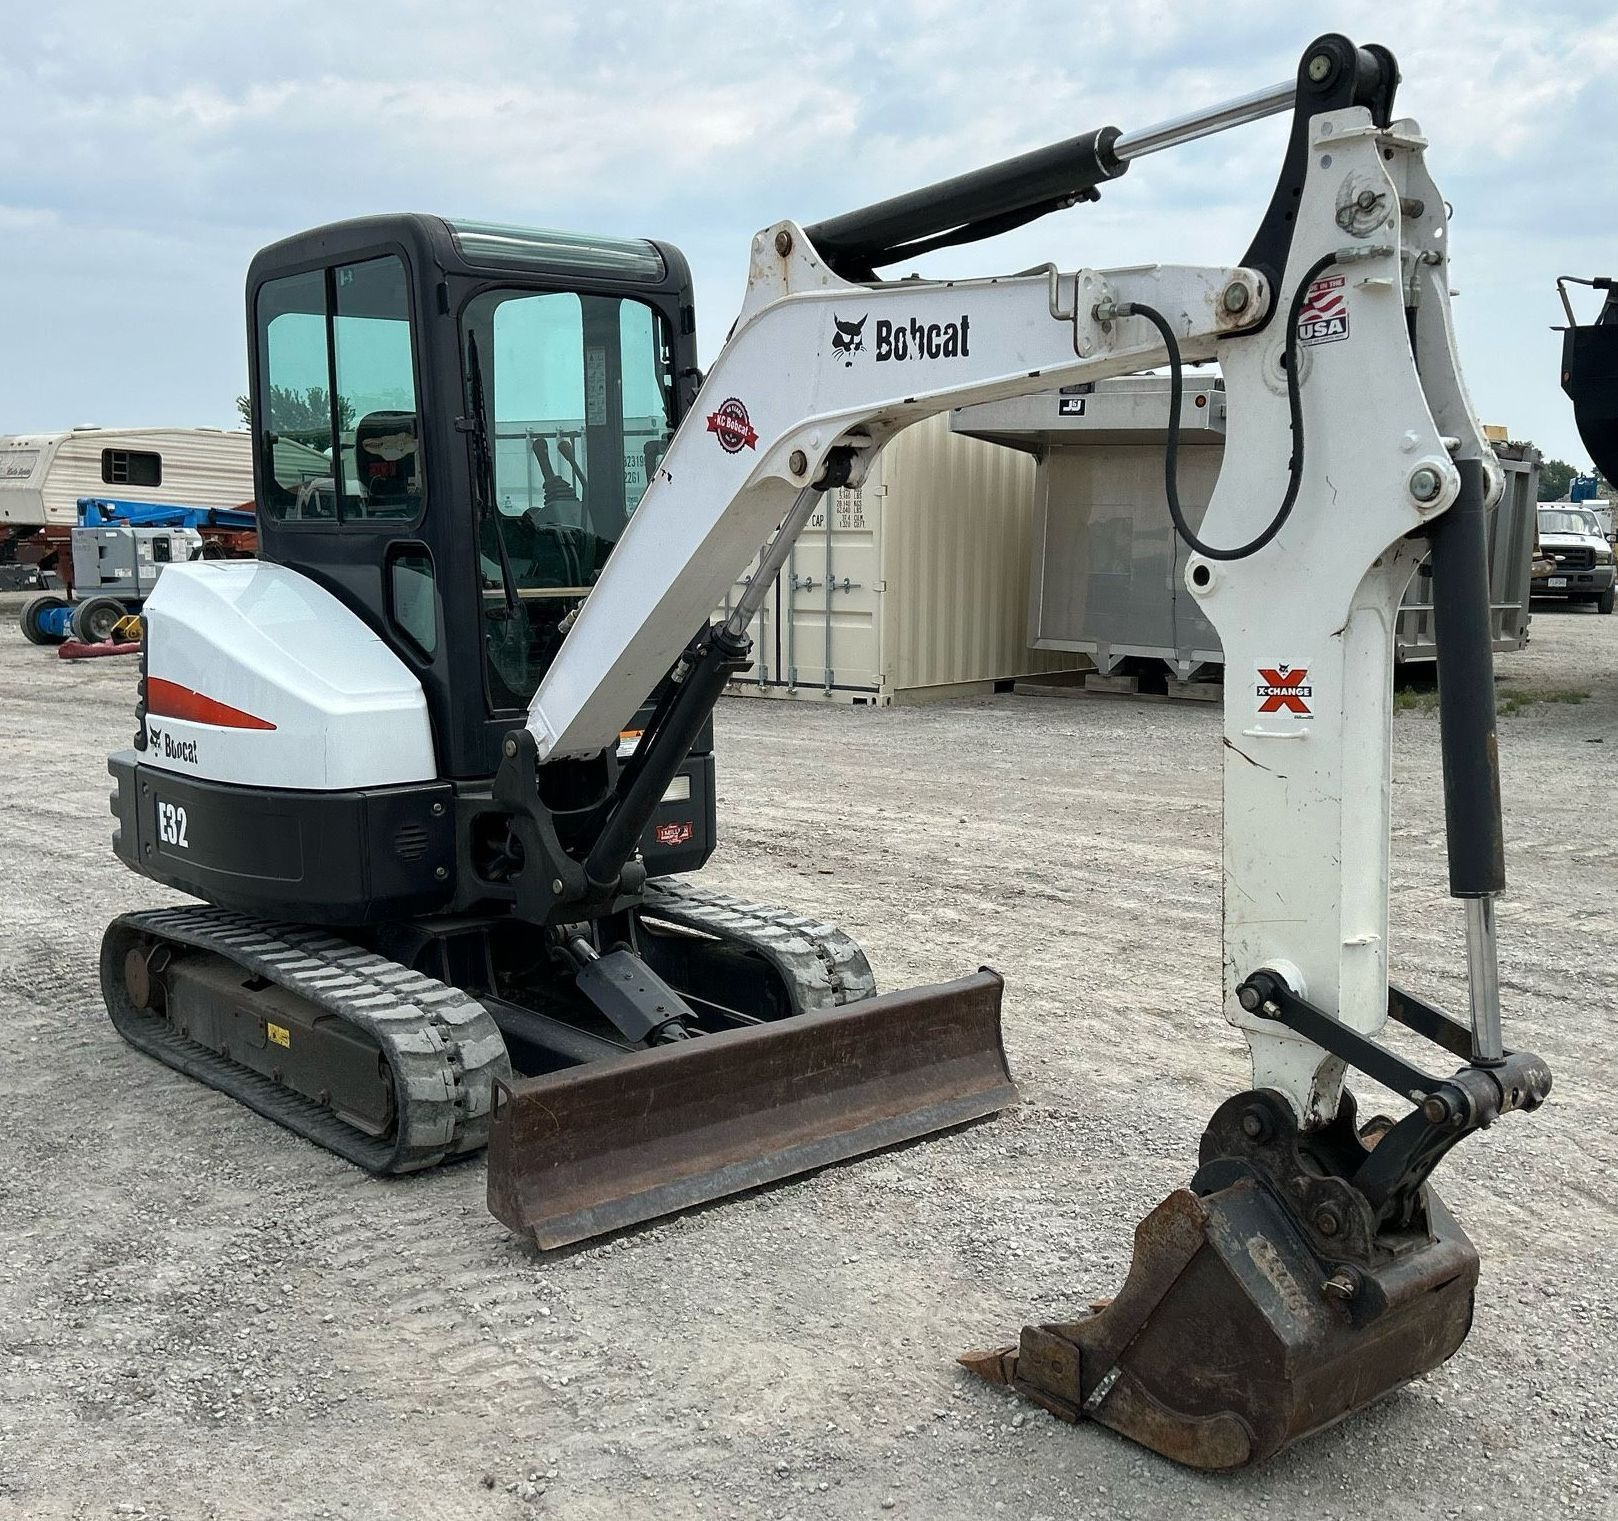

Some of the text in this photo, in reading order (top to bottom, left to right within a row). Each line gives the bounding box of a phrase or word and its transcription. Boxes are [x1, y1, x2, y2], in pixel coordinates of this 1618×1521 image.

[876, 315, 970, 361] Bobcat
[1299, 319, 1344, 340] USA
[717, 415, 749, 436] KC Bobcat
[158, 801, 189, 848] E32
